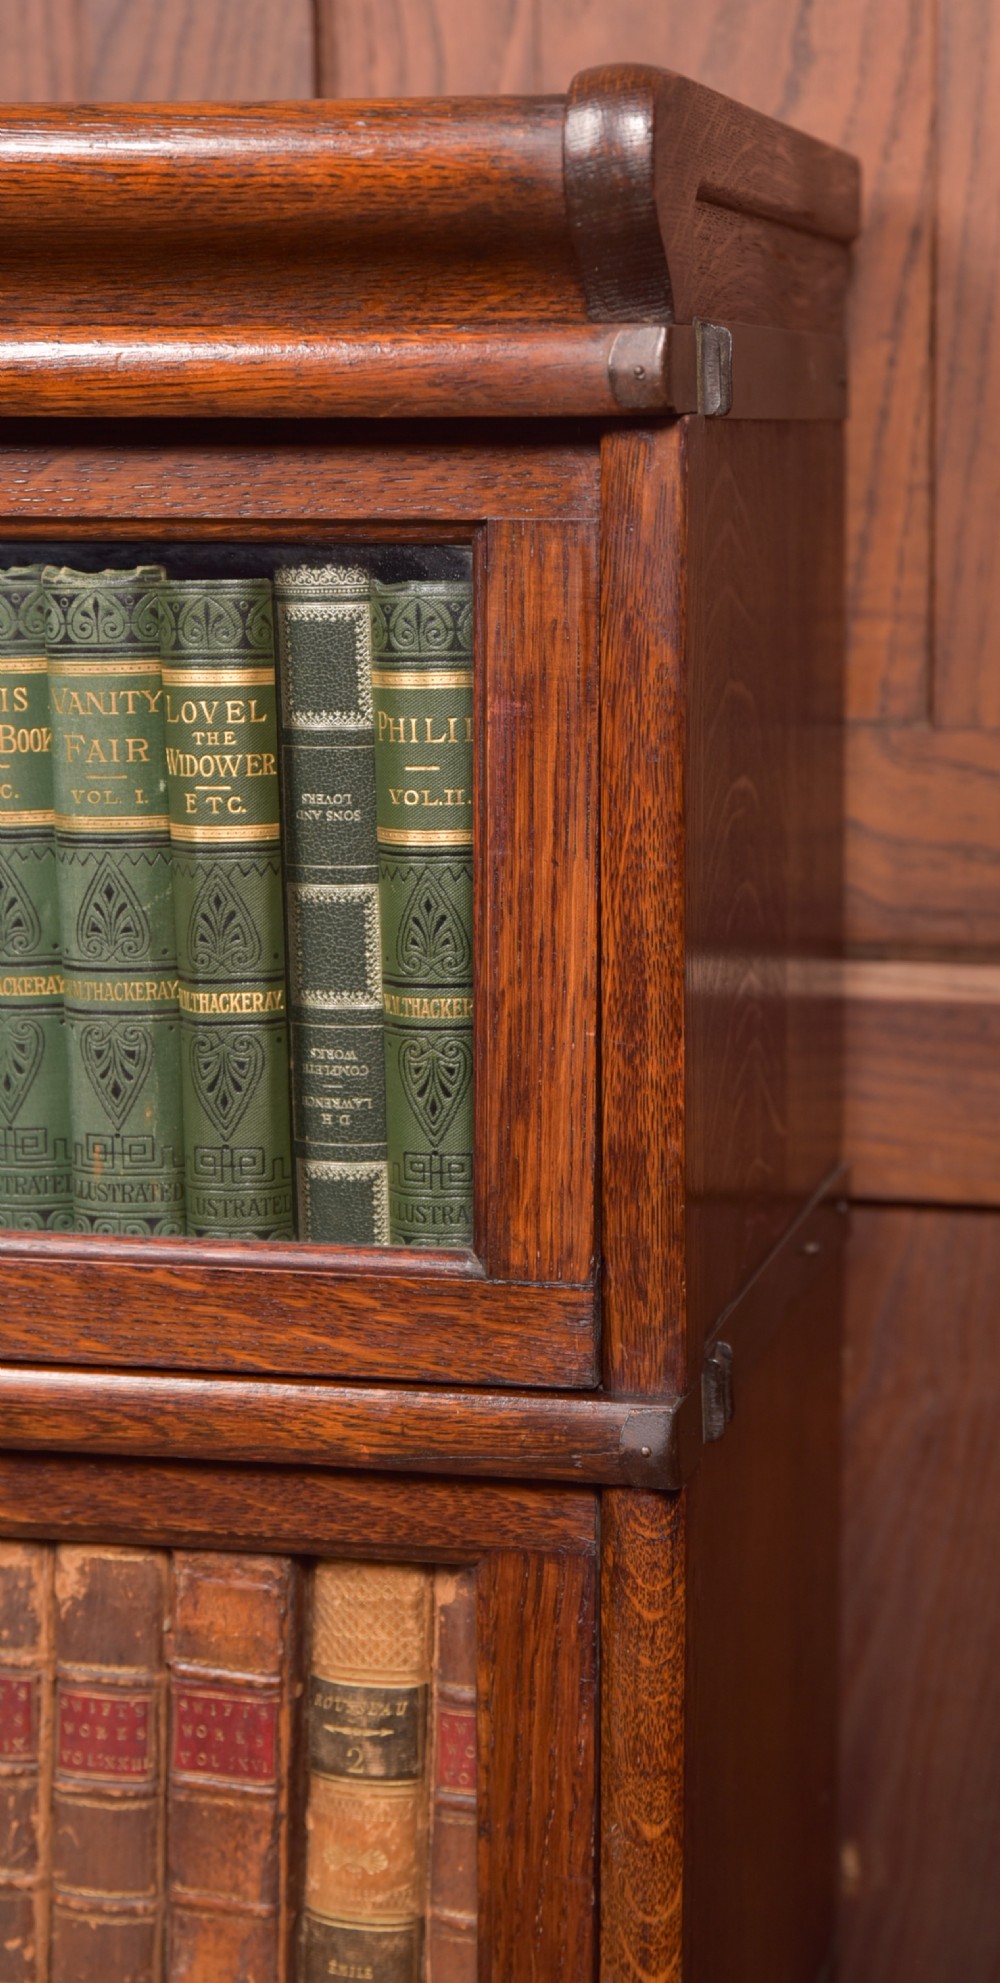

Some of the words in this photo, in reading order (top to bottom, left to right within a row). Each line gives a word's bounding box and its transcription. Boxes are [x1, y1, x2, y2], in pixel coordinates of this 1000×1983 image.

[51, 688, 163, 715] VANITY
[166, 695, 267, 724] LOVEL
[63, 734, 150, 763] FAIR
[192, 731, 237, 746] THE
[185, 793, 247, 814] ETC.
[301, 793, 352, 805] LOVERS
[296, 809, 323, 822] AND
[326, 810, 362, 822] SONS
[310, 1048, 358, 1060] WORKS
[63, 1721, 146, 1741] WORKS
[182, 1724, 264, 1748] WORKS
[346, 1746, 364, 1774] 2
